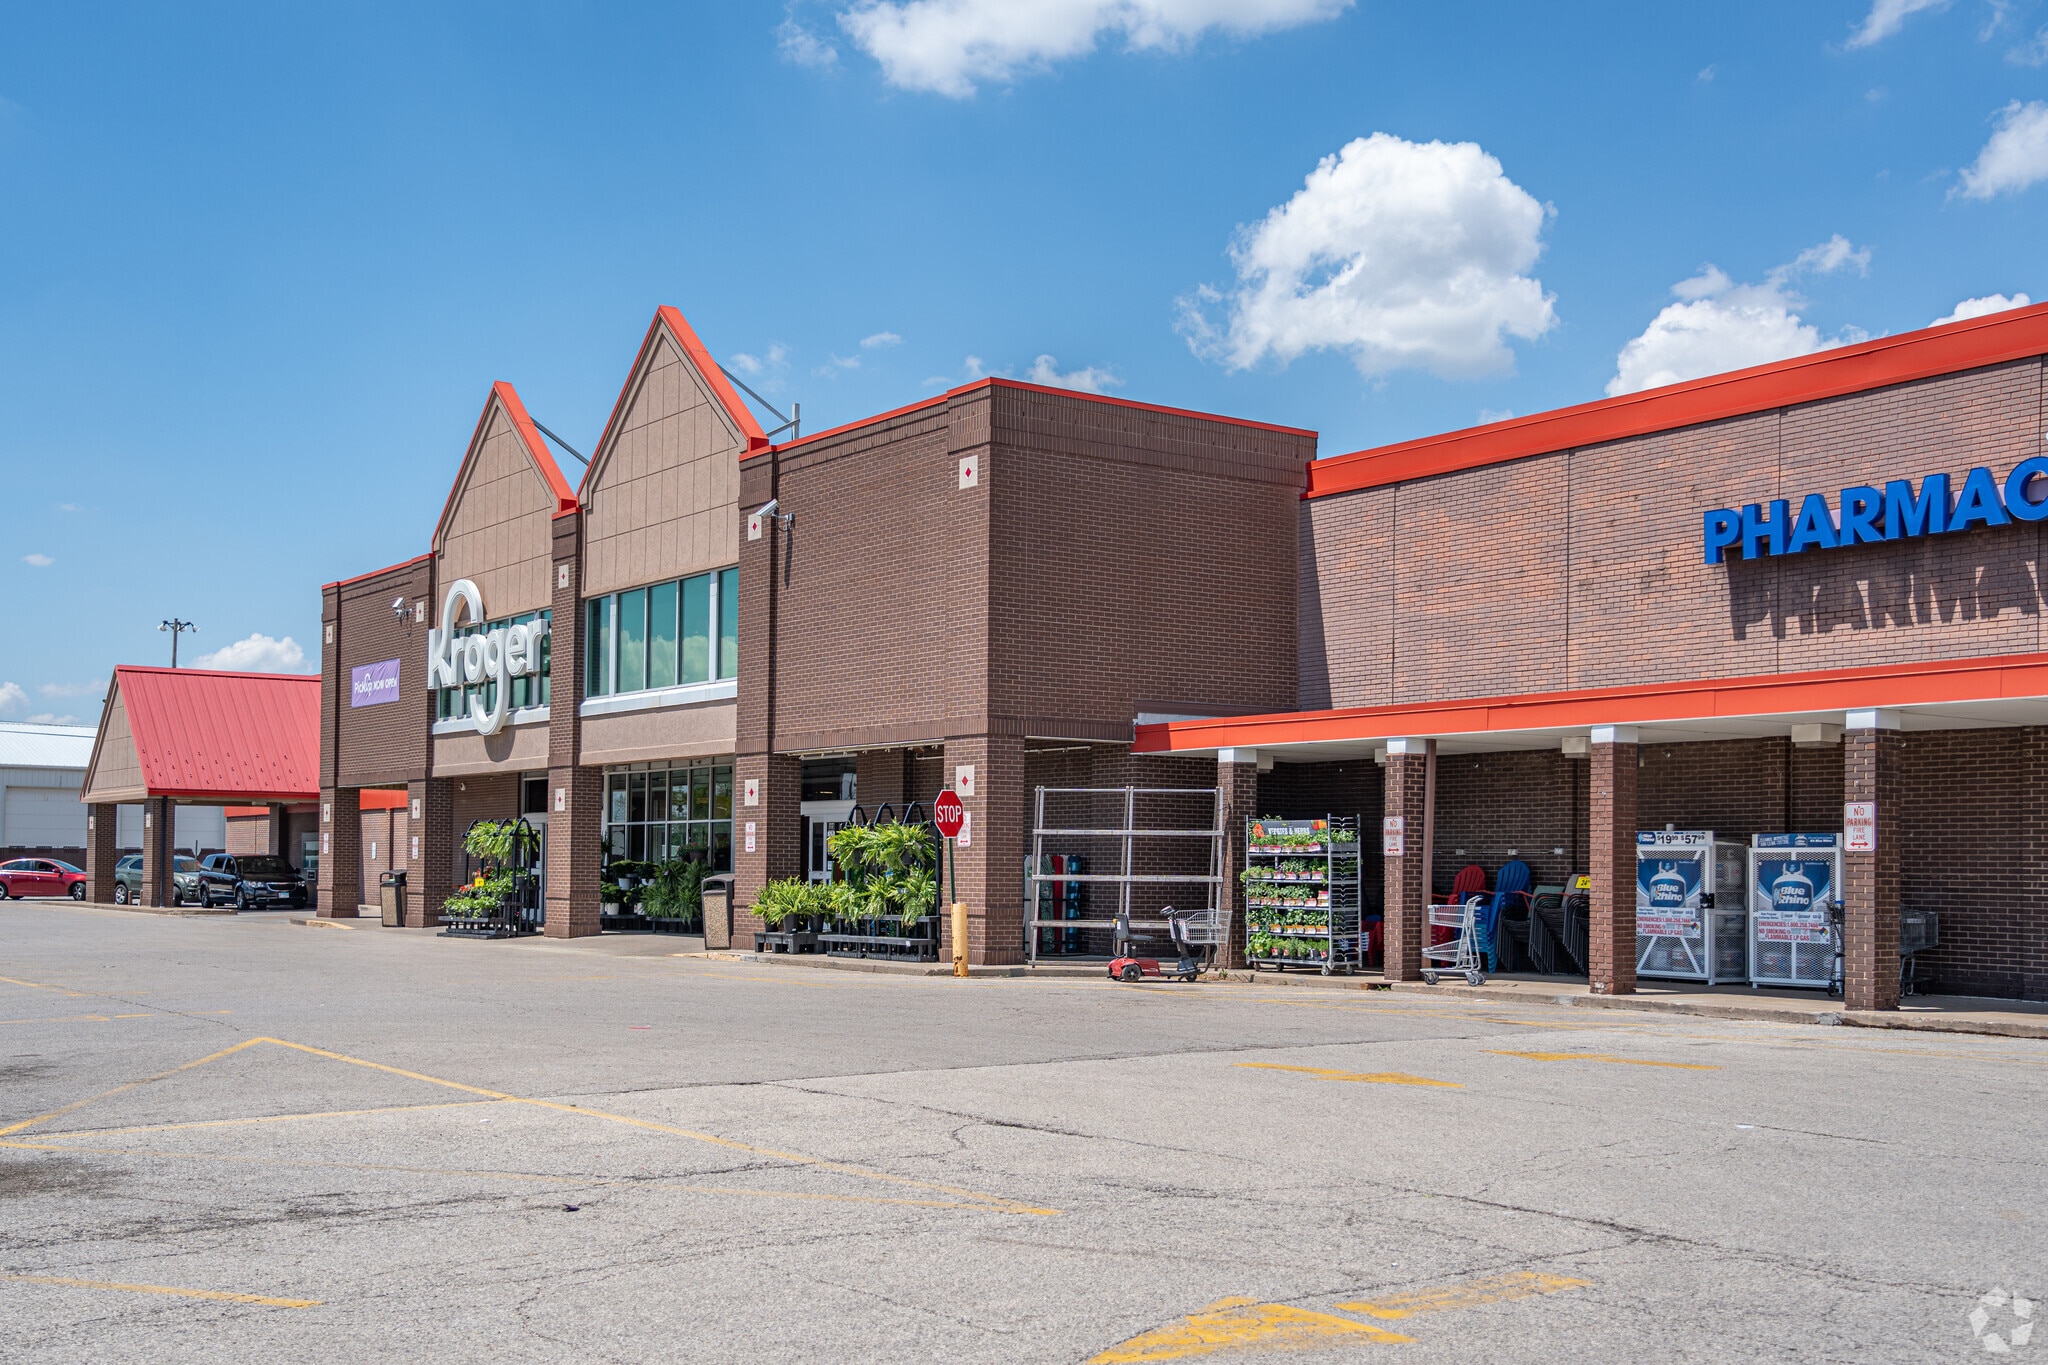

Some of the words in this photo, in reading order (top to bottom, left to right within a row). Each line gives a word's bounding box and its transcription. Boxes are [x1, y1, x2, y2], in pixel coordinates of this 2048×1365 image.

[428, 579, 549, 736] Kroger
[385, 677, 397, 688] OPEN
[937, 805, 962, 823] STOP
[1854, 808, 1864, 816] NO
[1389, 820, 1398, 828] NO
[1847, 818, 1871, 826] PARKING
[1657, 883, 1679, 892] Blue
[1780, 886, 1805, 895] Blue
